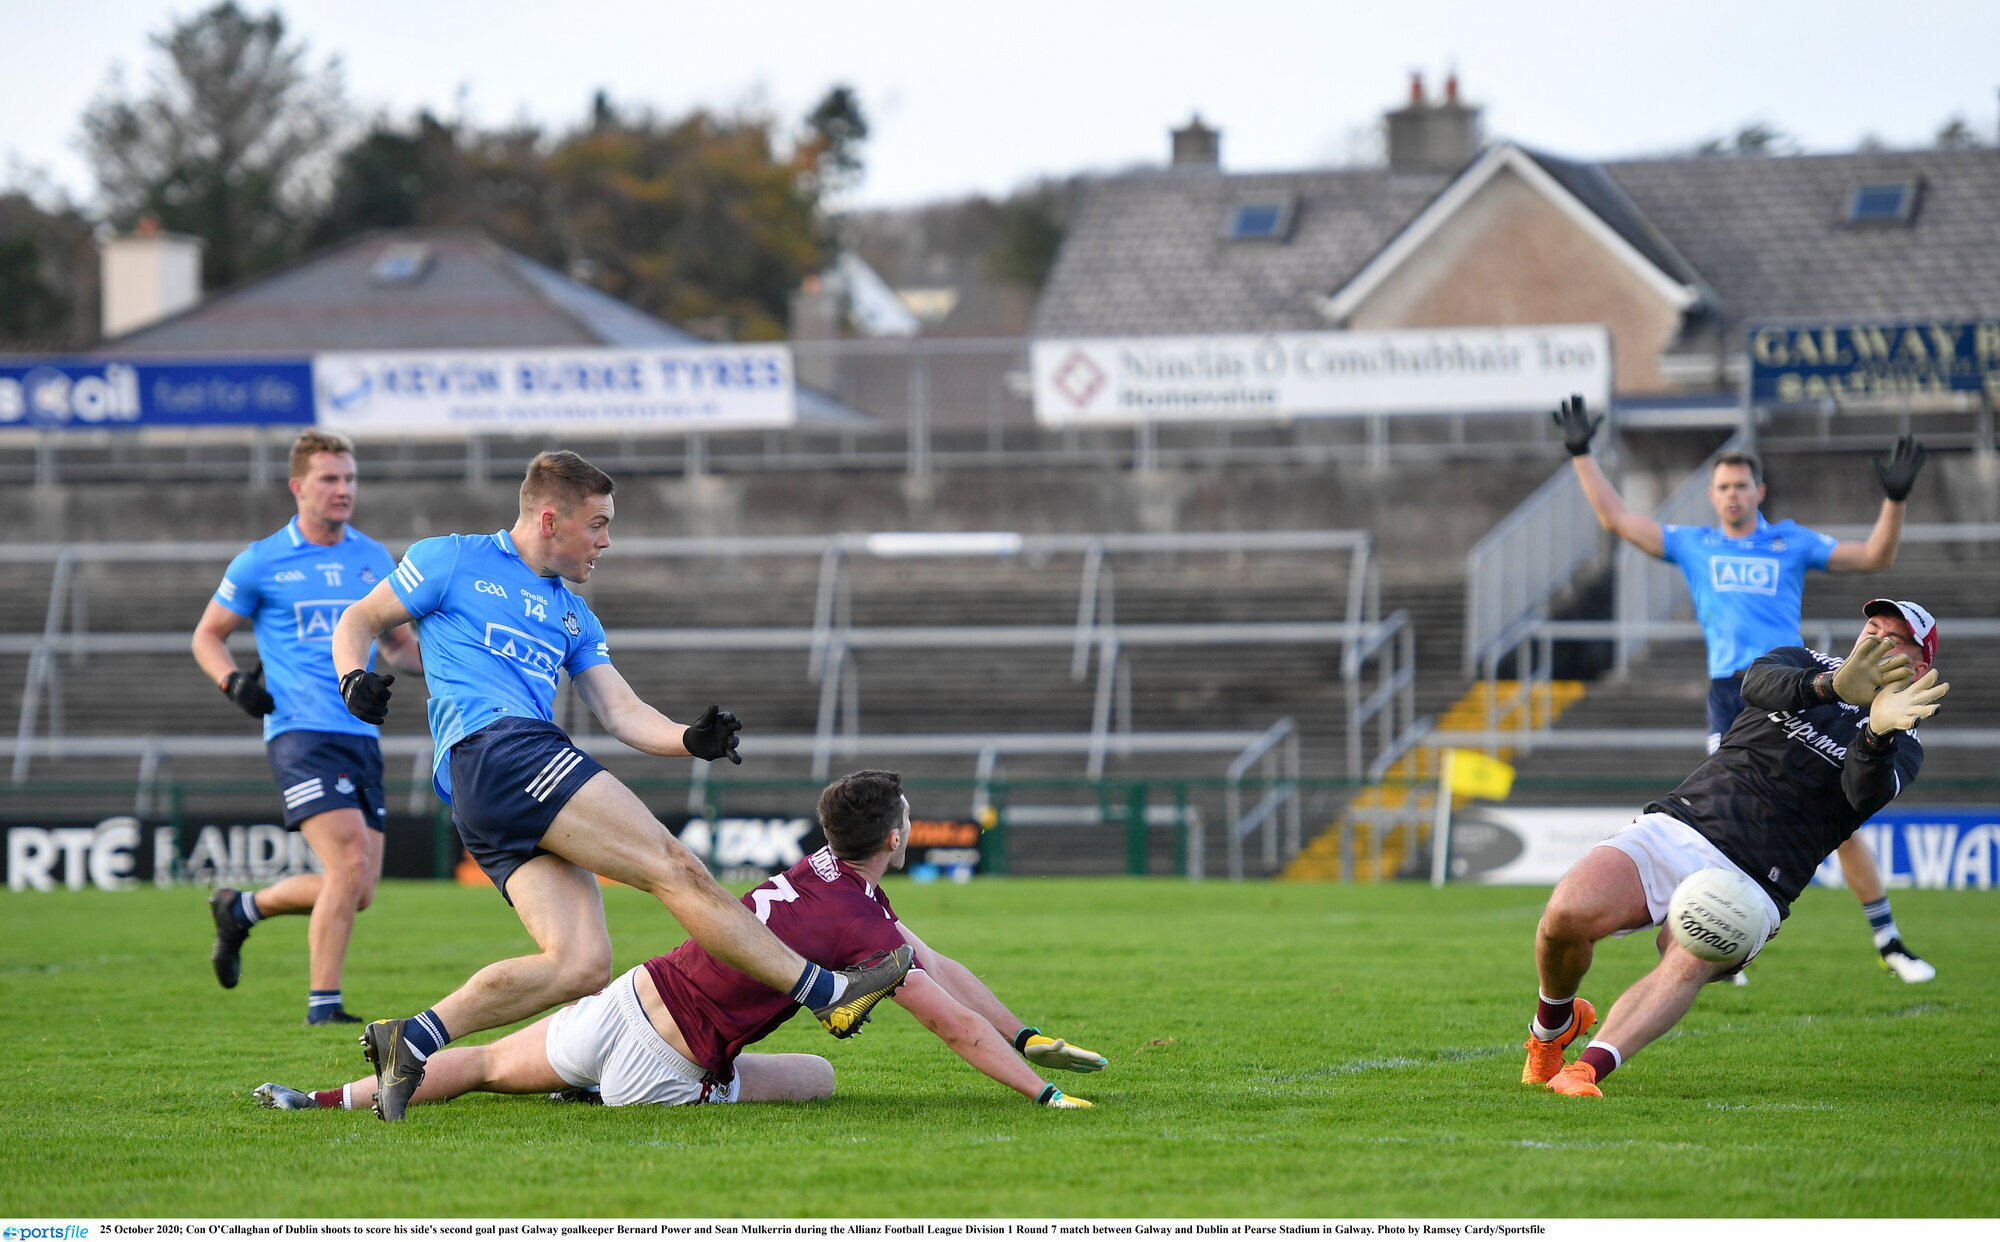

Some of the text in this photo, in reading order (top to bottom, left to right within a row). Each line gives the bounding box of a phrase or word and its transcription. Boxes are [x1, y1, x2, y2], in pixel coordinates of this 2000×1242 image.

[1755, 324, 1964, 368] GALWAY
[381, 358, 782, 395] KEVIN BURKE TYRES
[324, 571, 342, 587] 11
[1720, 563, 1770, 587] AIG
[520, 589, 549, 606] oneills
[523, 598, 548, 622] 14
[306, 607, 340, 634] AI
[501, 638, 557, 681] AIG
[7, 816, 140, 893] RTÉ
